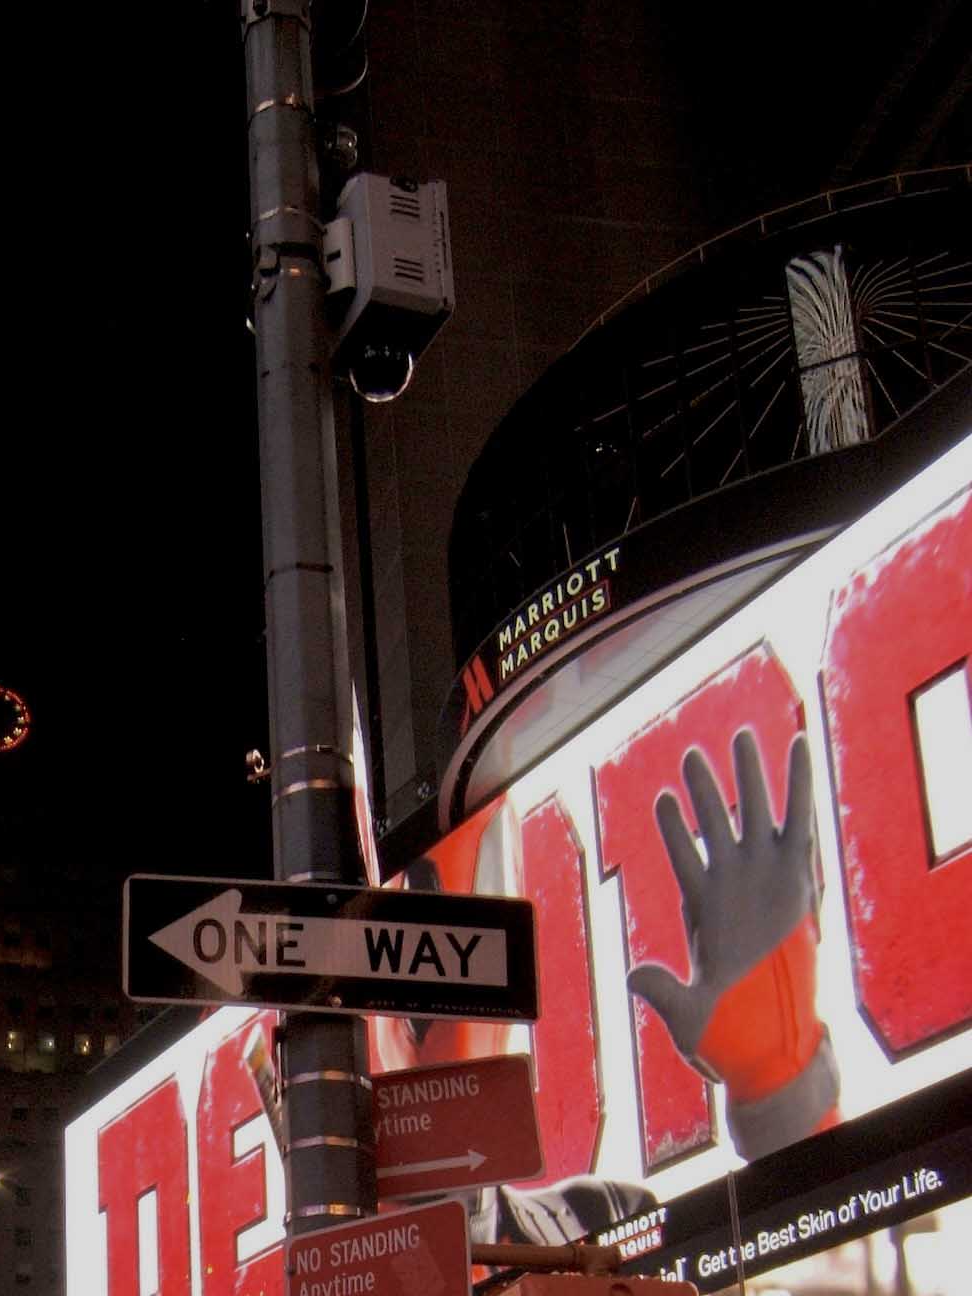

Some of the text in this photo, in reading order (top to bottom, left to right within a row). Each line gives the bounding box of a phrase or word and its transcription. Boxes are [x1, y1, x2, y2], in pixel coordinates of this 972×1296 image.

[498, 548, 620, 651] MARRIOTT
[501, 588, 605, 680] MARQUIS
[192, 918, 482, 978] ONE WAY
[377, 1073, 480, 1111] STANDING
[373, 1111, 432, 1144] ytime
[597, 1207, 667, 1247] MARRIOTT
[619, 1229, 664, 1259] QUIS
[698, 1249, 727, 1277] Get
[757, 1223, 797, 1255] Best
[797, 1208, 835, 1240] Skin
[838, 1197, 857, 1224] of
[858, 1184, 900, 1215] Your
[902, 1168, 943, 1199] Life.
[296, 1223, 421, 1275] NO STANDING
